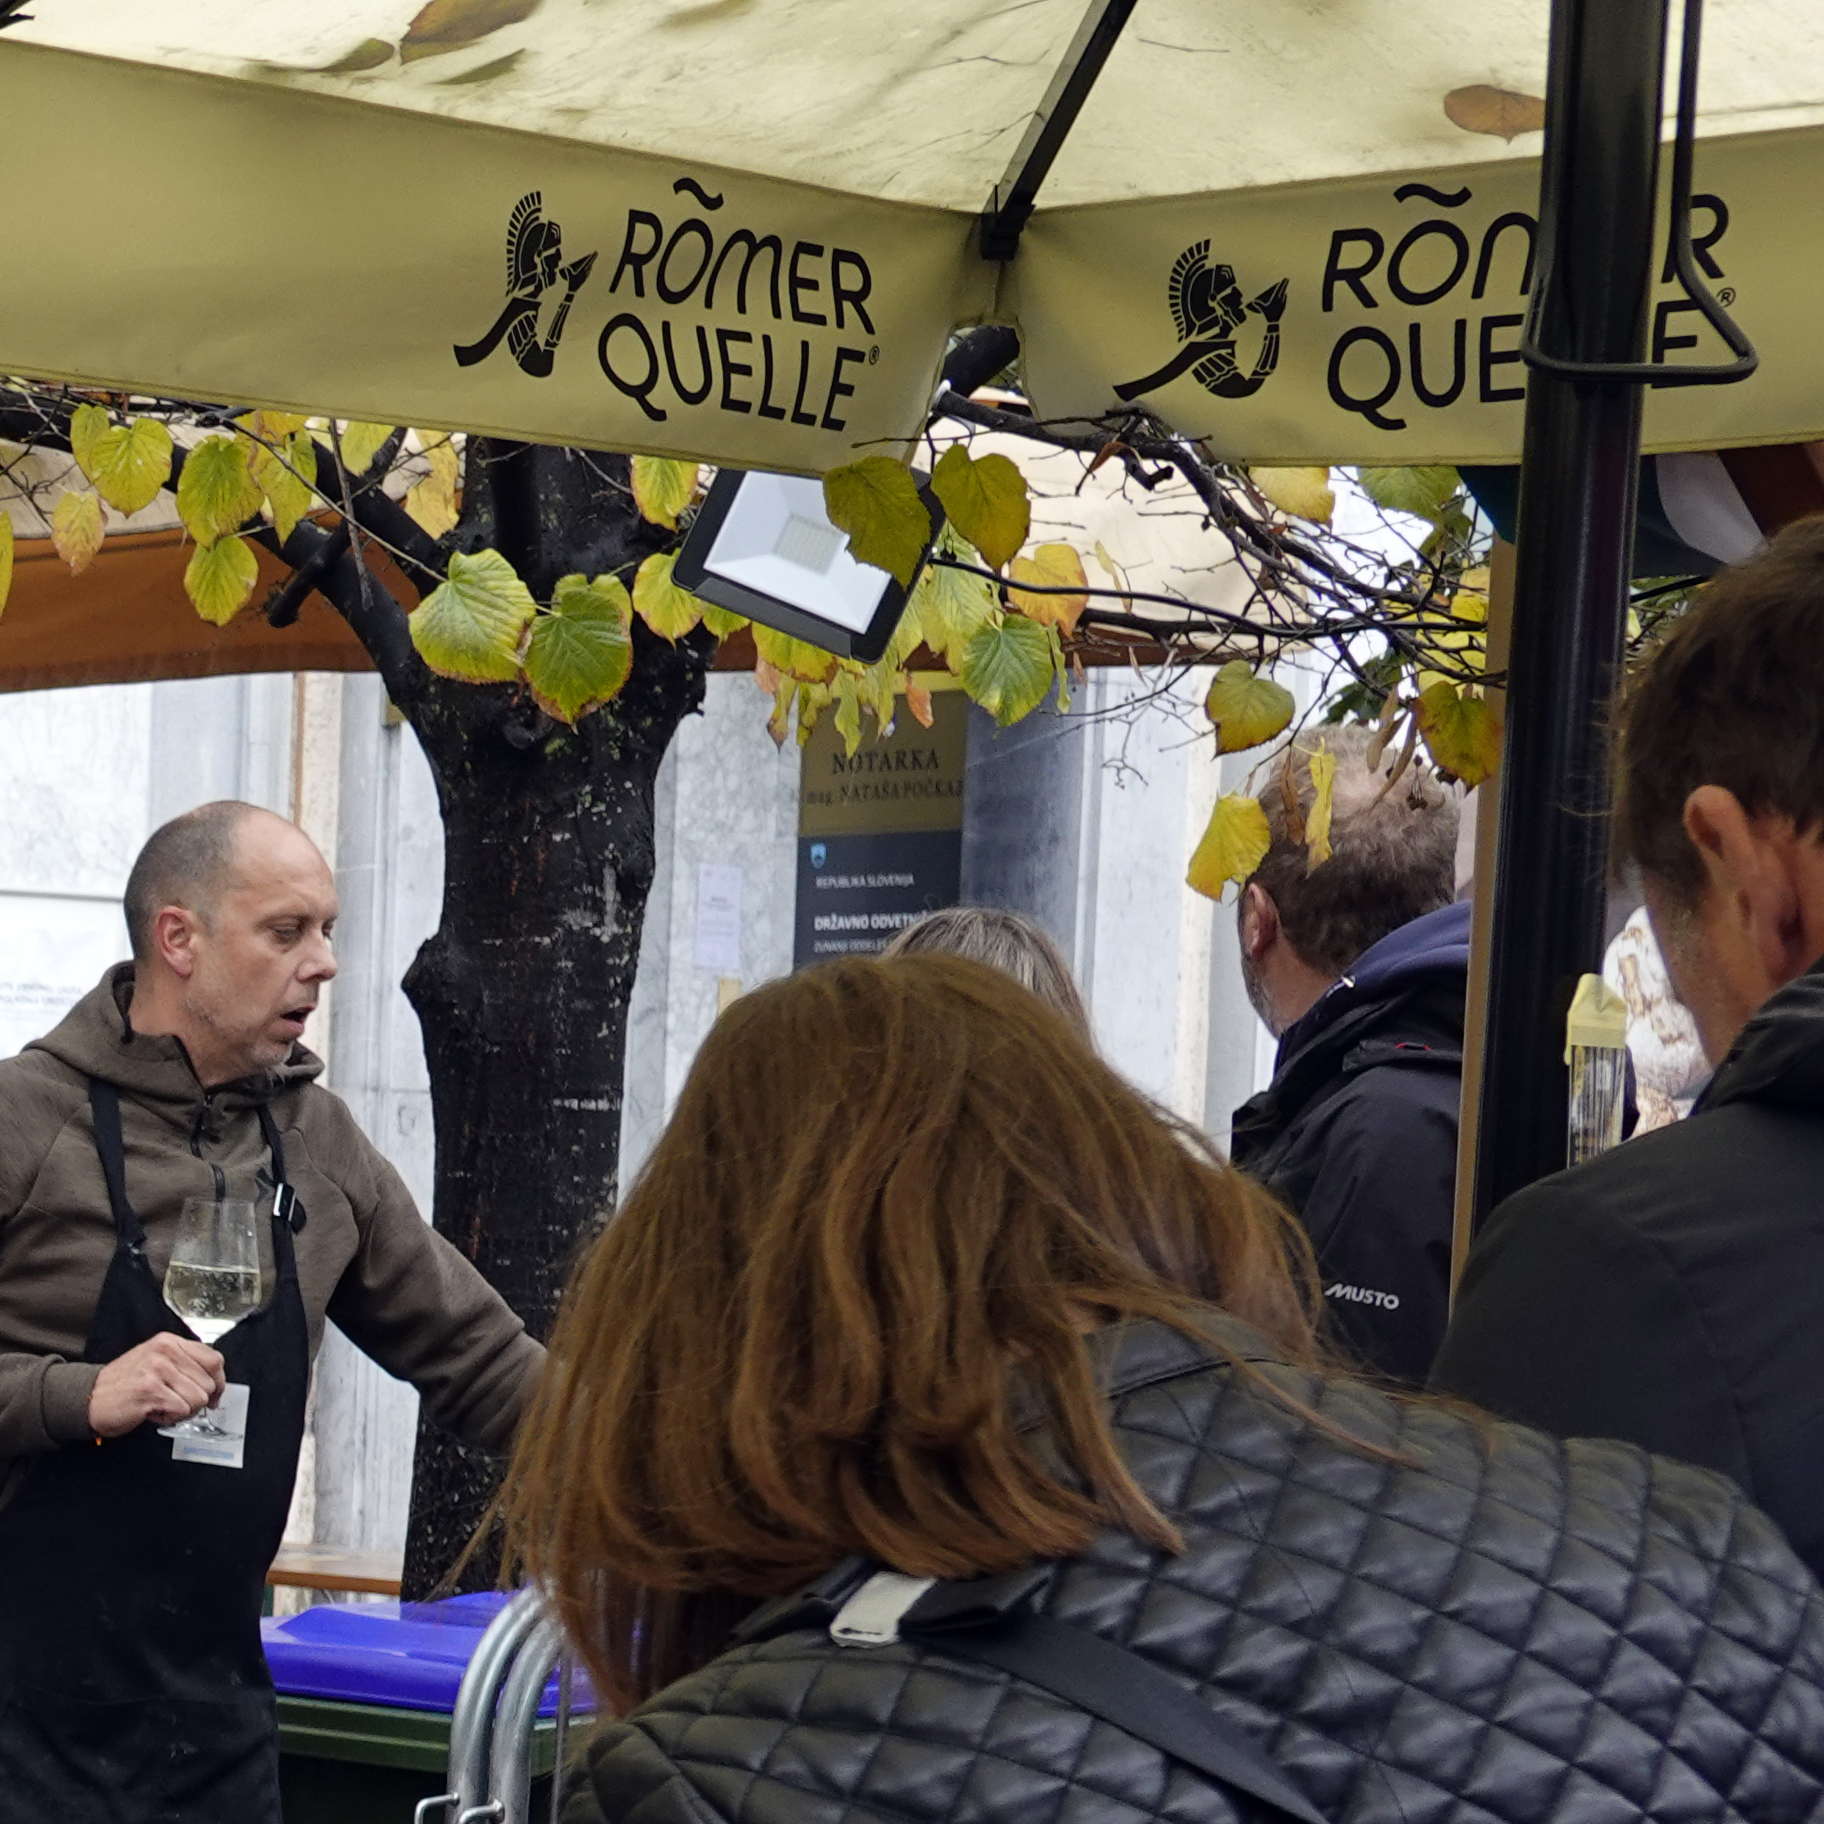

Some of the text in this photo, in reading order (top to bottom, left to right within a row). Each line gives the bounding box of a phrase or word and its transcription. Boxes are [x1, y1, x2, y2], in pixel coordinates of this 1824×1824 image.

[832, 748, 940, 775] NOTARKA
[813, 912, 869, 932] DRŽAVNO
[1324, 1282, 1400, 1311] MUSTO
